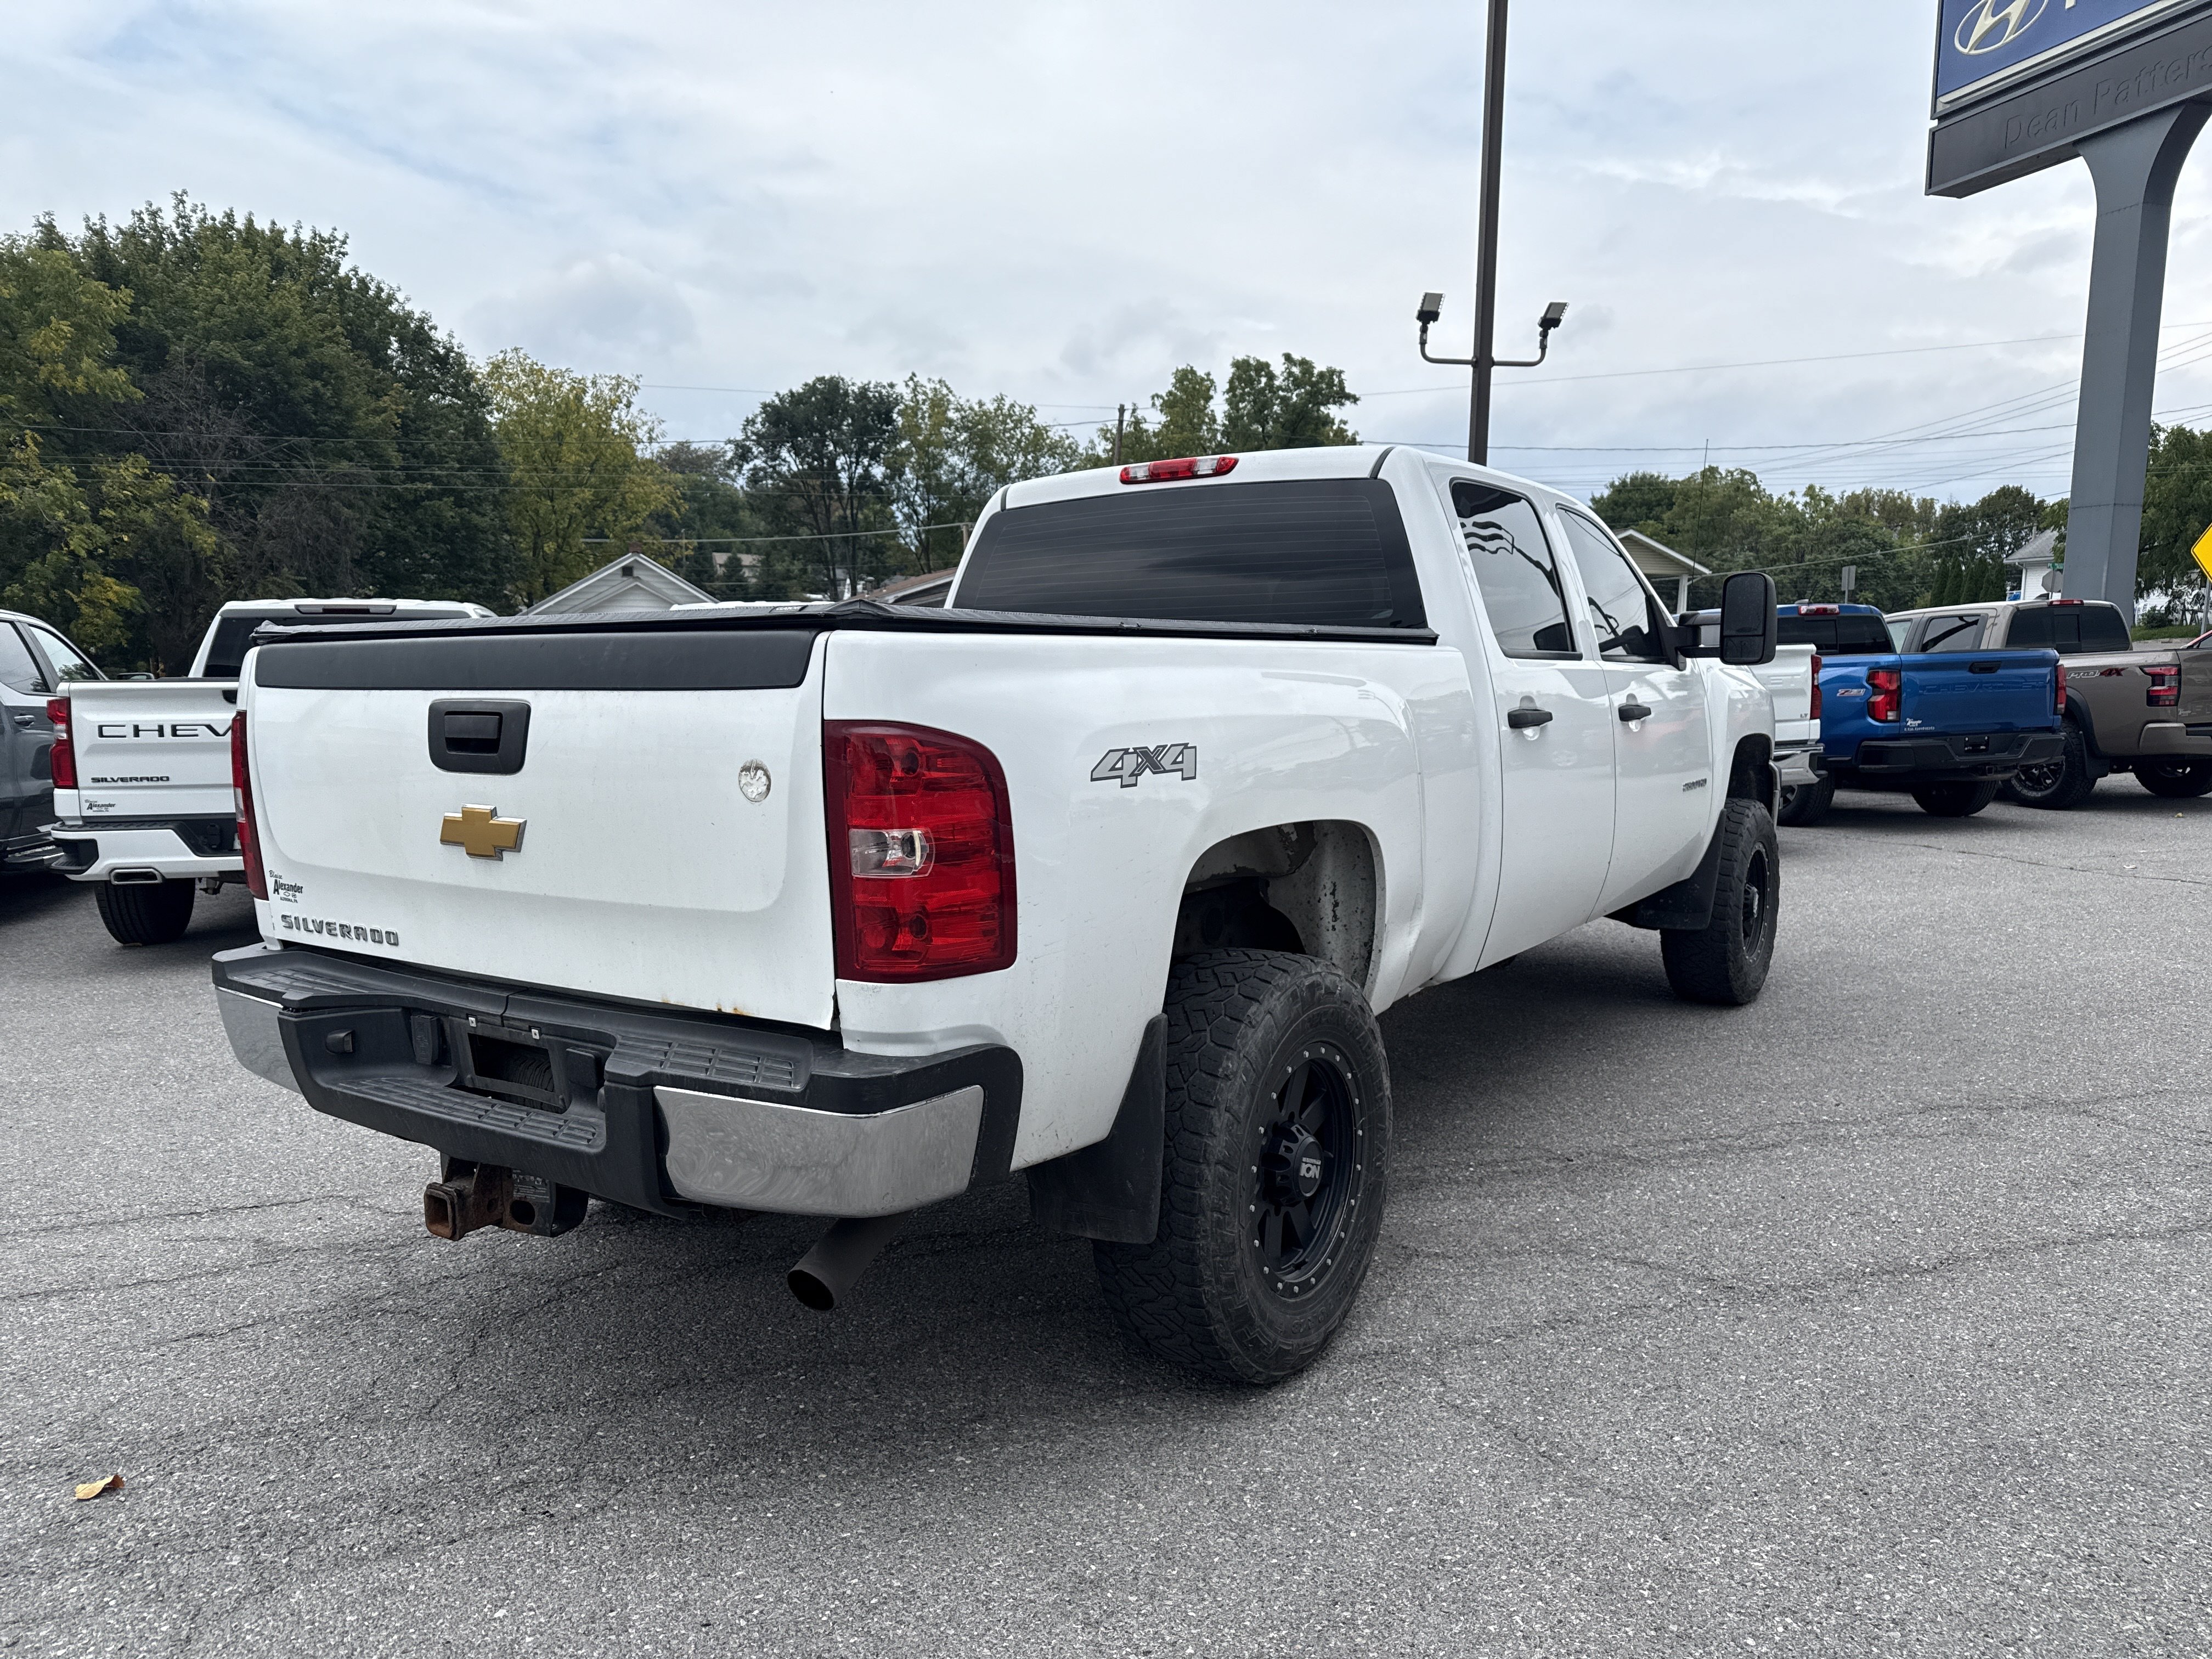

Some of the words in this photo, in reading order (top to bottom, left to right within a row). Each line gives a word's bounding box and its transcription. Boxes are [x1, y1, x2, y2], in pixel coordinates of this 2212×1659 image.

[2005, 99, 2078, 149] Dean
[269, 870, 283, 879] Blaise
[273, 879, 303, 895] Alexander
[281, 914, 398, 946] SILVERADO
[1299, 1162, 1321, 1179] ION
